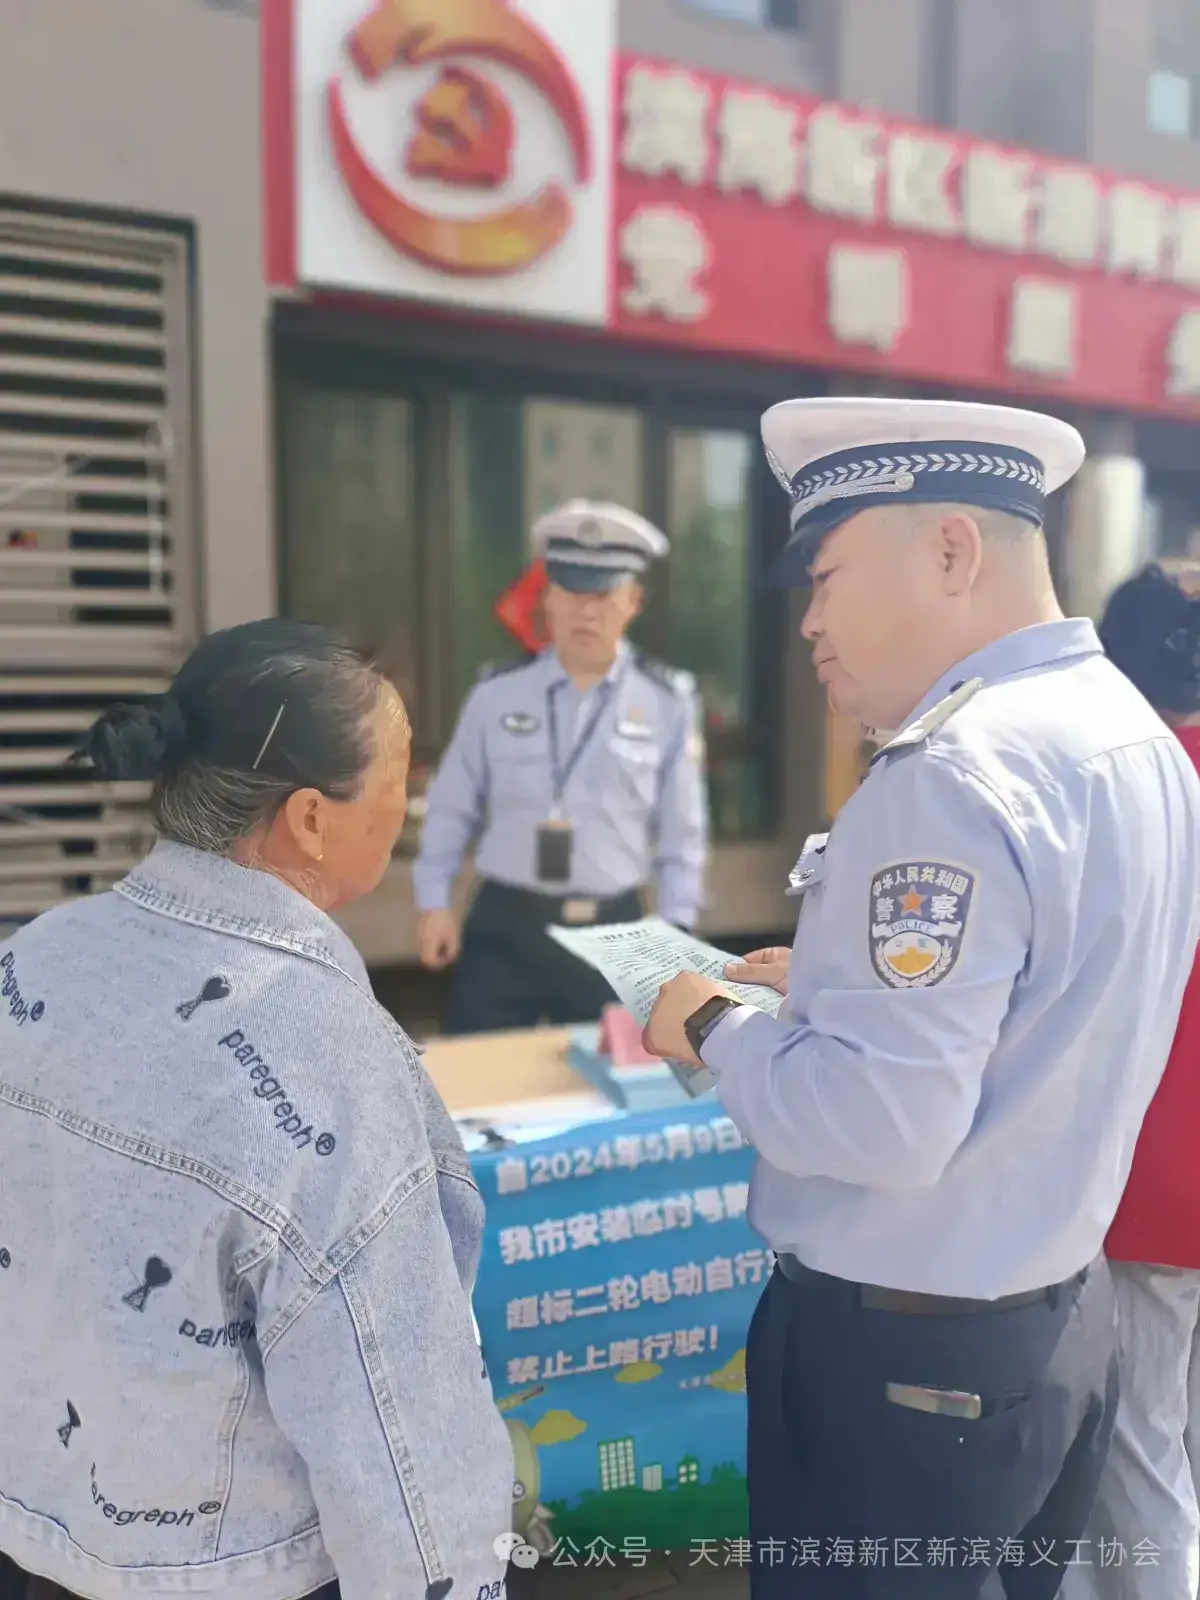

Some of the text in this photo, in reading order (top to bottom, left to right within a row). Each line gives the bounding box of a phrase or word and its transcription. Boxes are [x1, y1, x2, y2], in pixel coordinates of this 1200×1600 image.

[872, 866, 969, 897] 中华人民共和国
[890, 920, 935, 934] POLICE
[218, 1028, 315, 1149] paregreph
[496, 1116, 748, 1195] 自2024年5月9日
